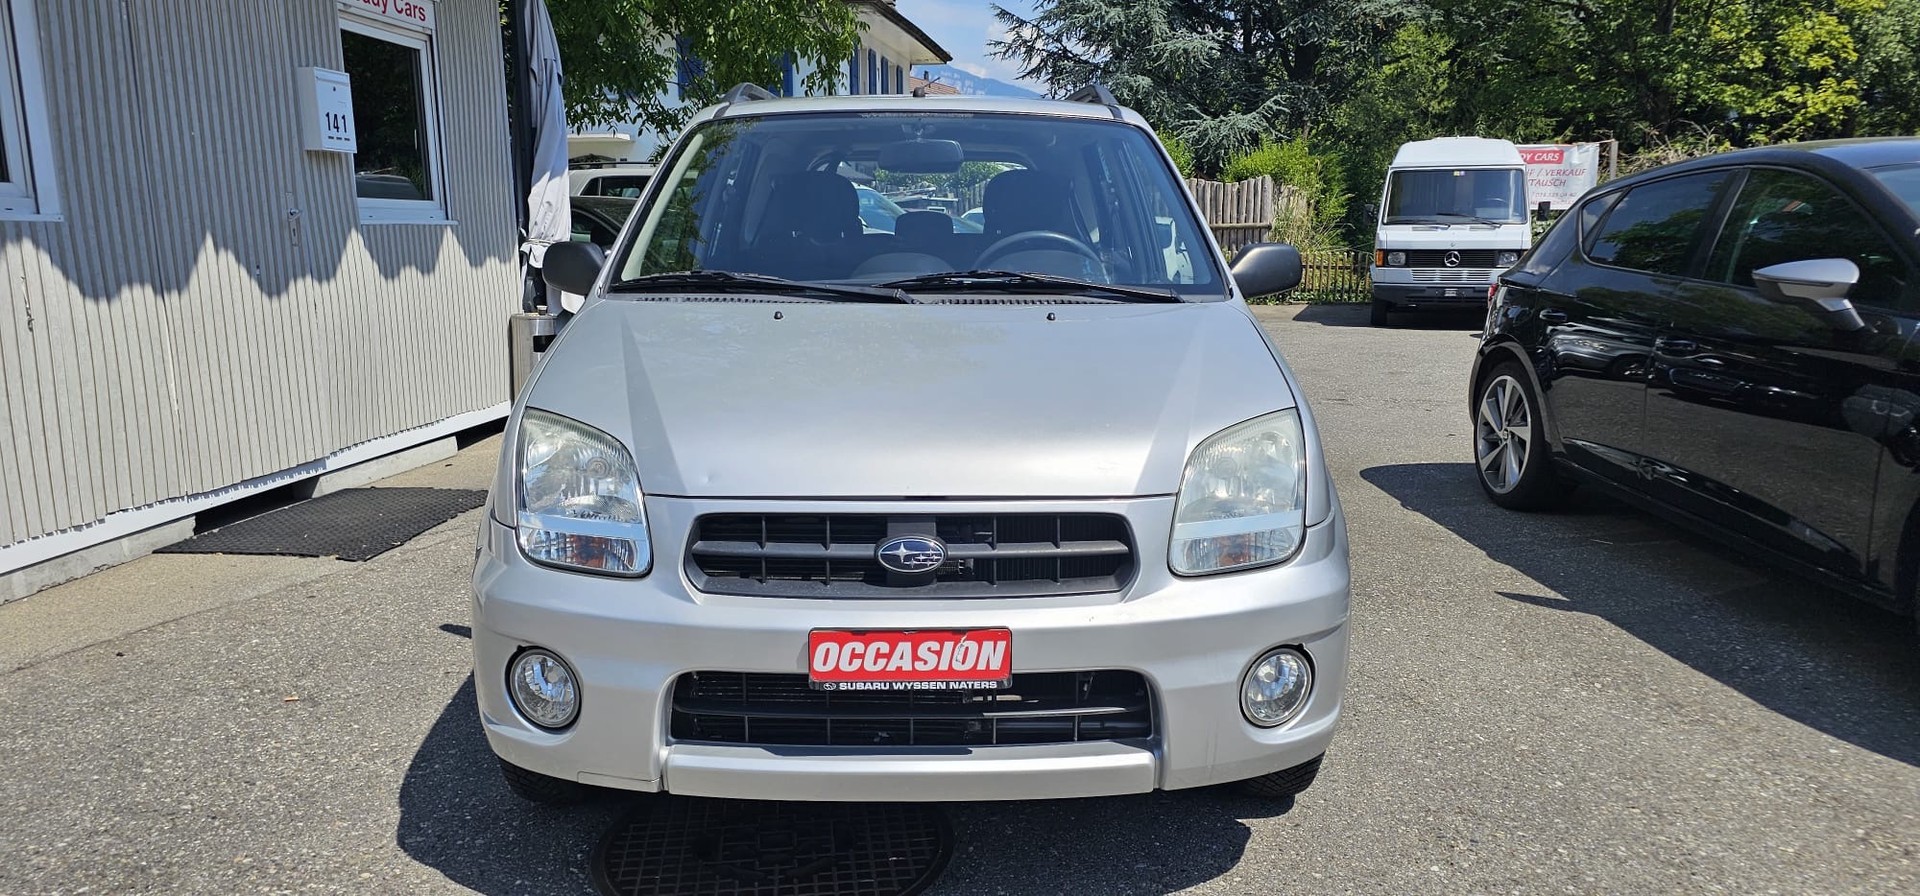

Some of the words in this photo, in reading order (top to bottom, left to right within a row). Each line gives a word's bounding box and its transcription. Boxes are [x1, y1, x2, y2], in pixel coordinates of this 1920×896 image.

[393, 0, 427, 21] Cars
[325, 112, 347, 133] 141
[1520, 153, 1533, 161] DY
[1534, 153, 1560, 161] CARS
[1545, 168, 1587, 177] VERKAUF
[812, 640, 1007, 672] OCCASION
[839, 682, 890, 691] SUBARU
[892, 681, 947, 690] WYSSEN
[949, 681, 998, 690] NATERS
